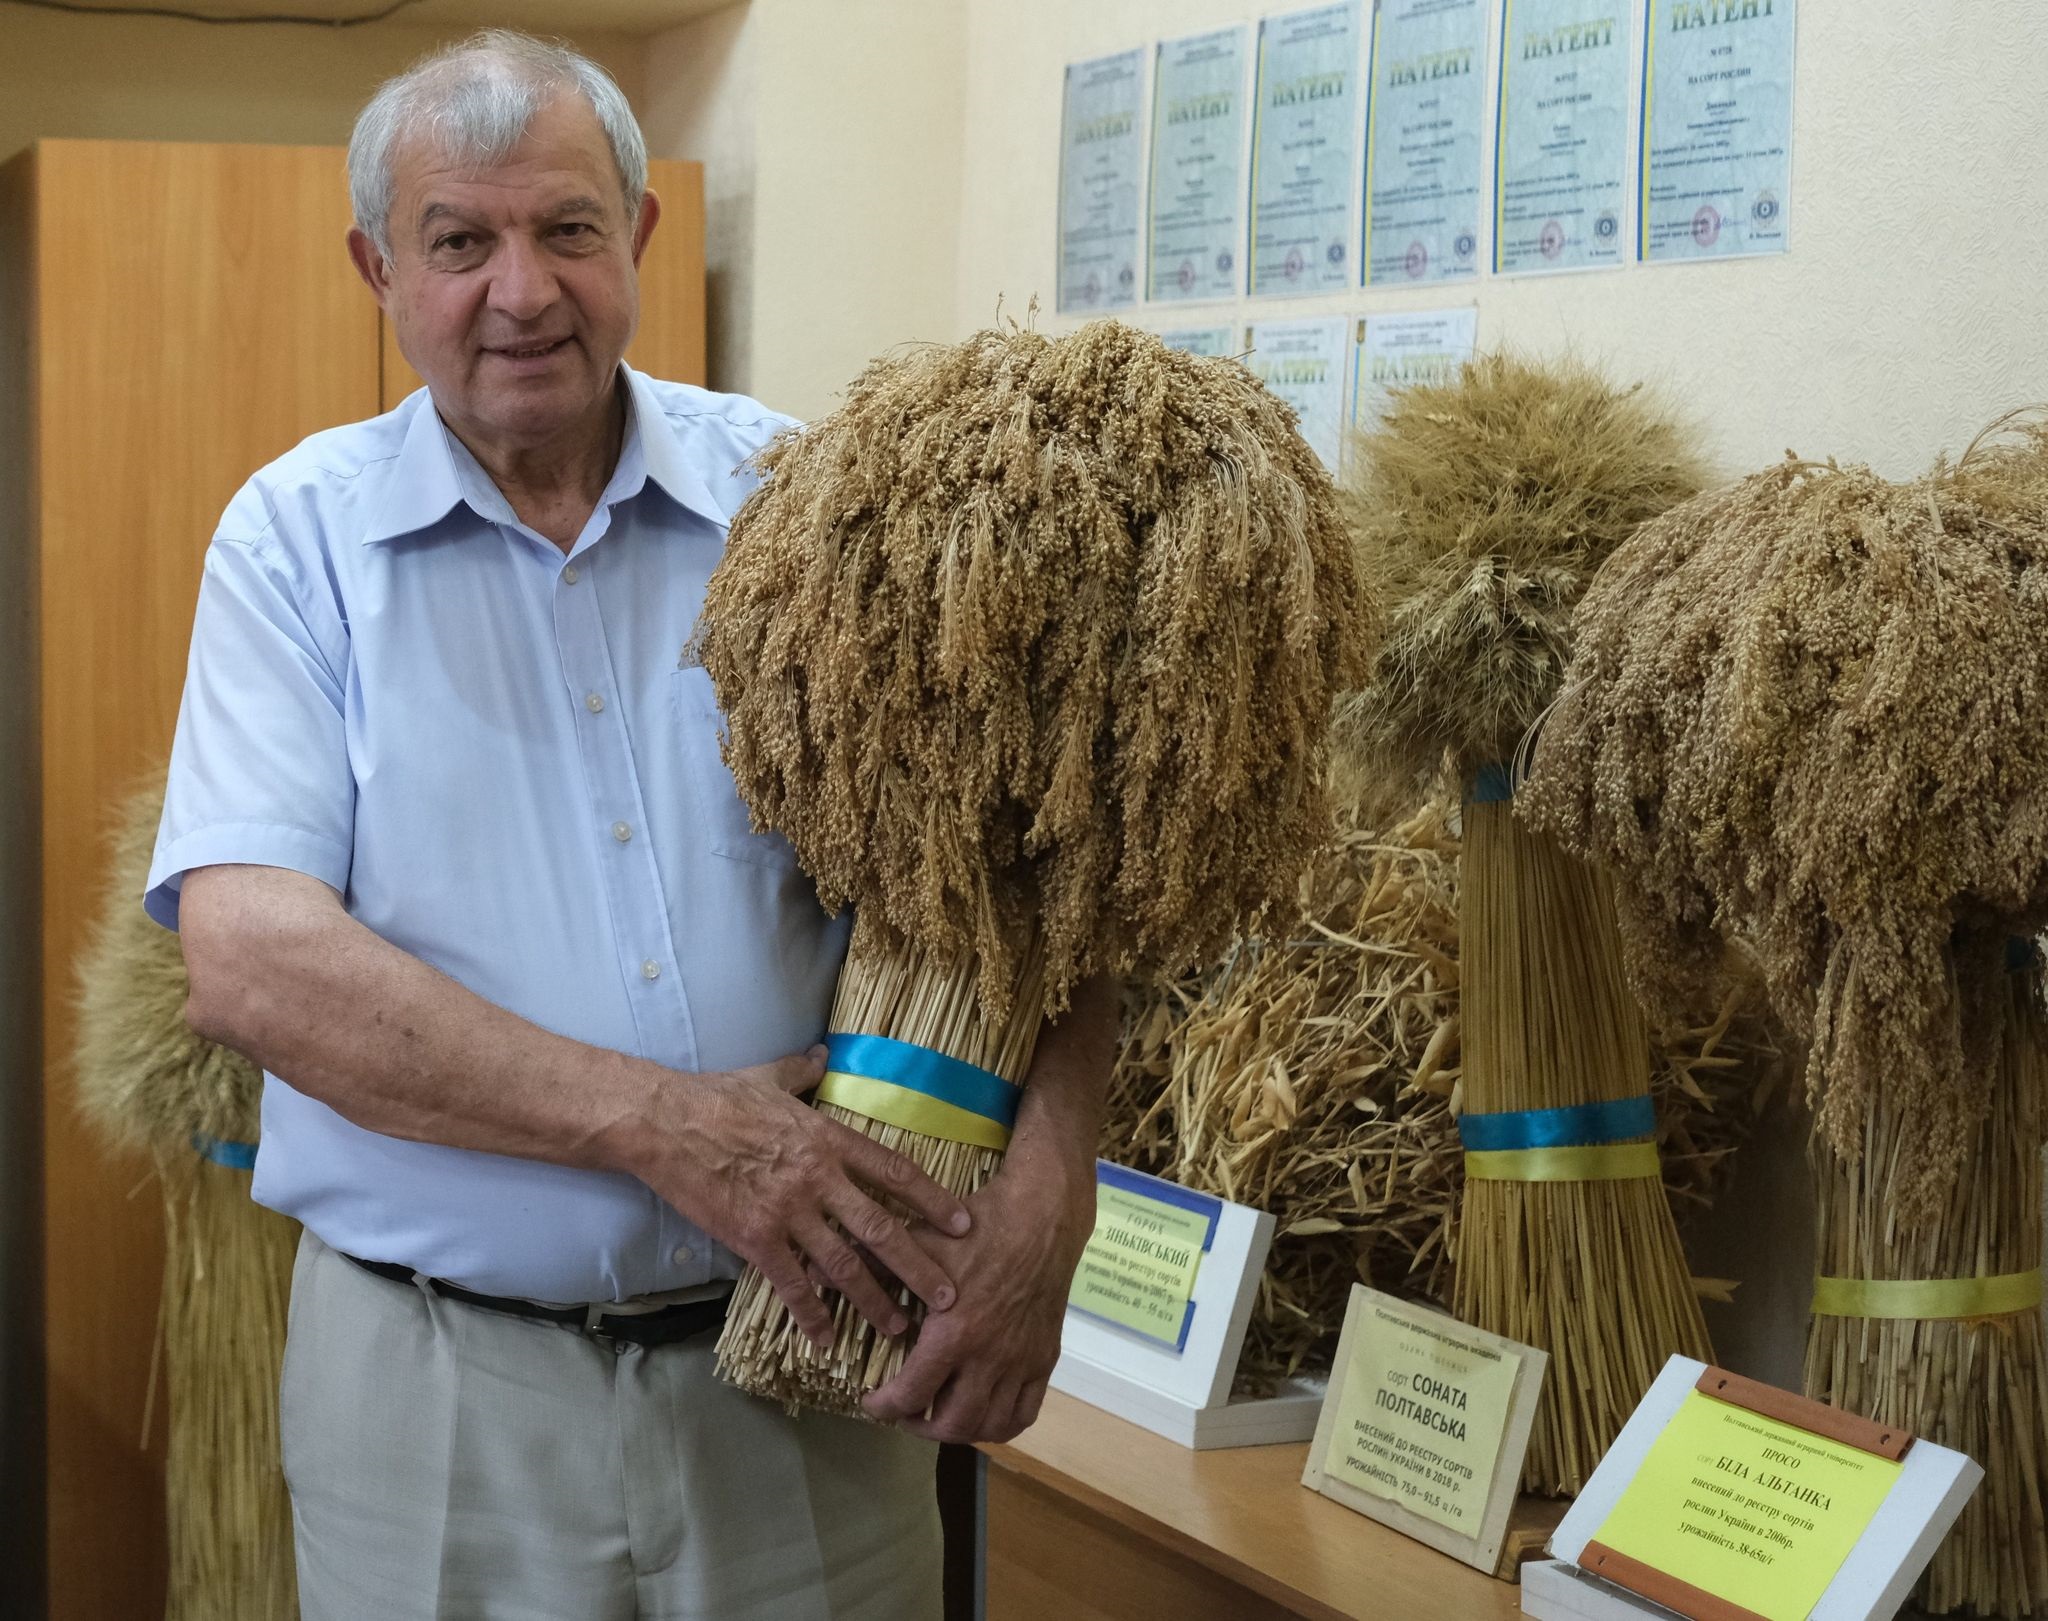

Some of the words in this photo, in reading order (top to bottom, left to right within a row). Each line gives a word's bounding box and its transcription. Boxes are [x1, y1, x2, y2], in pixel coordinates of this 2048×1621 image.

[1522, 17, 1616, 60] ПАТЕНТ
[1389, 47, 1474, 88] ПАТЕНТ
[1105, 1225, 1191, 1268] ЗИНЬКІВСЬКИЙ
[1126, 1212, 1164, 1234] ГОРОХ
[1375, 1388, 1466, 1442] ПОЛТАВСЬКА
[1412, 1373, 1466, 1411] СОНАТА
[1354, 1419, 1395, 1446] ВНЕСЕНИЙ
[1395, 1438, 1408, 1451] ДО
[1409, 1444, 1443, 1466] РЕЄСТРУ
[1443, 1458, 1473, 1480] СОРТІВ
[1357, 1437, 1389, 1460] РОСЛИН
[1389, 1451, 1424, 1475] УКРАЇНИ
[1425, 1468, 1431, 1478] В
[1432, 1471, 1452, 1488] 2018
[1723, 1415, 1763, 1435] Полтавський
[1763, 1430, 1797, 1447] державний
[1797, 1440, 1826, 1457] аграрний
[1826, 1452, 1864, 1471] університет
[1761, 1448, 1801, 1469] ПРОСО
[1346, 1455, 1399, 1488] УРОЖАЙНІСТЬ
[1401, 1480, 1417, 1496] 75,0
[1423, 1491, 1441, 1507] 91,5
[1691, 1477, 1733, 1499] внесений
[1733, 1493, 1745, 1503] до
[1744, 1498, 1780, 1519] реєстру
[1783, 1512, 1815, 1531] сортів
[1715, 1456, 1750, 1479] БІЛА
[1752, 1471, 1832, 1511] АЛЬТАНКА
[1677, 1521, 1735, 1550] урожайність
[1683, 1498, 1717, 1518] рослин
[1717, 1509, 1756, 1533] України
[1757, 1528, 1764, 1536] в
[1764, 1528, 1794, 1550] 2006р.
